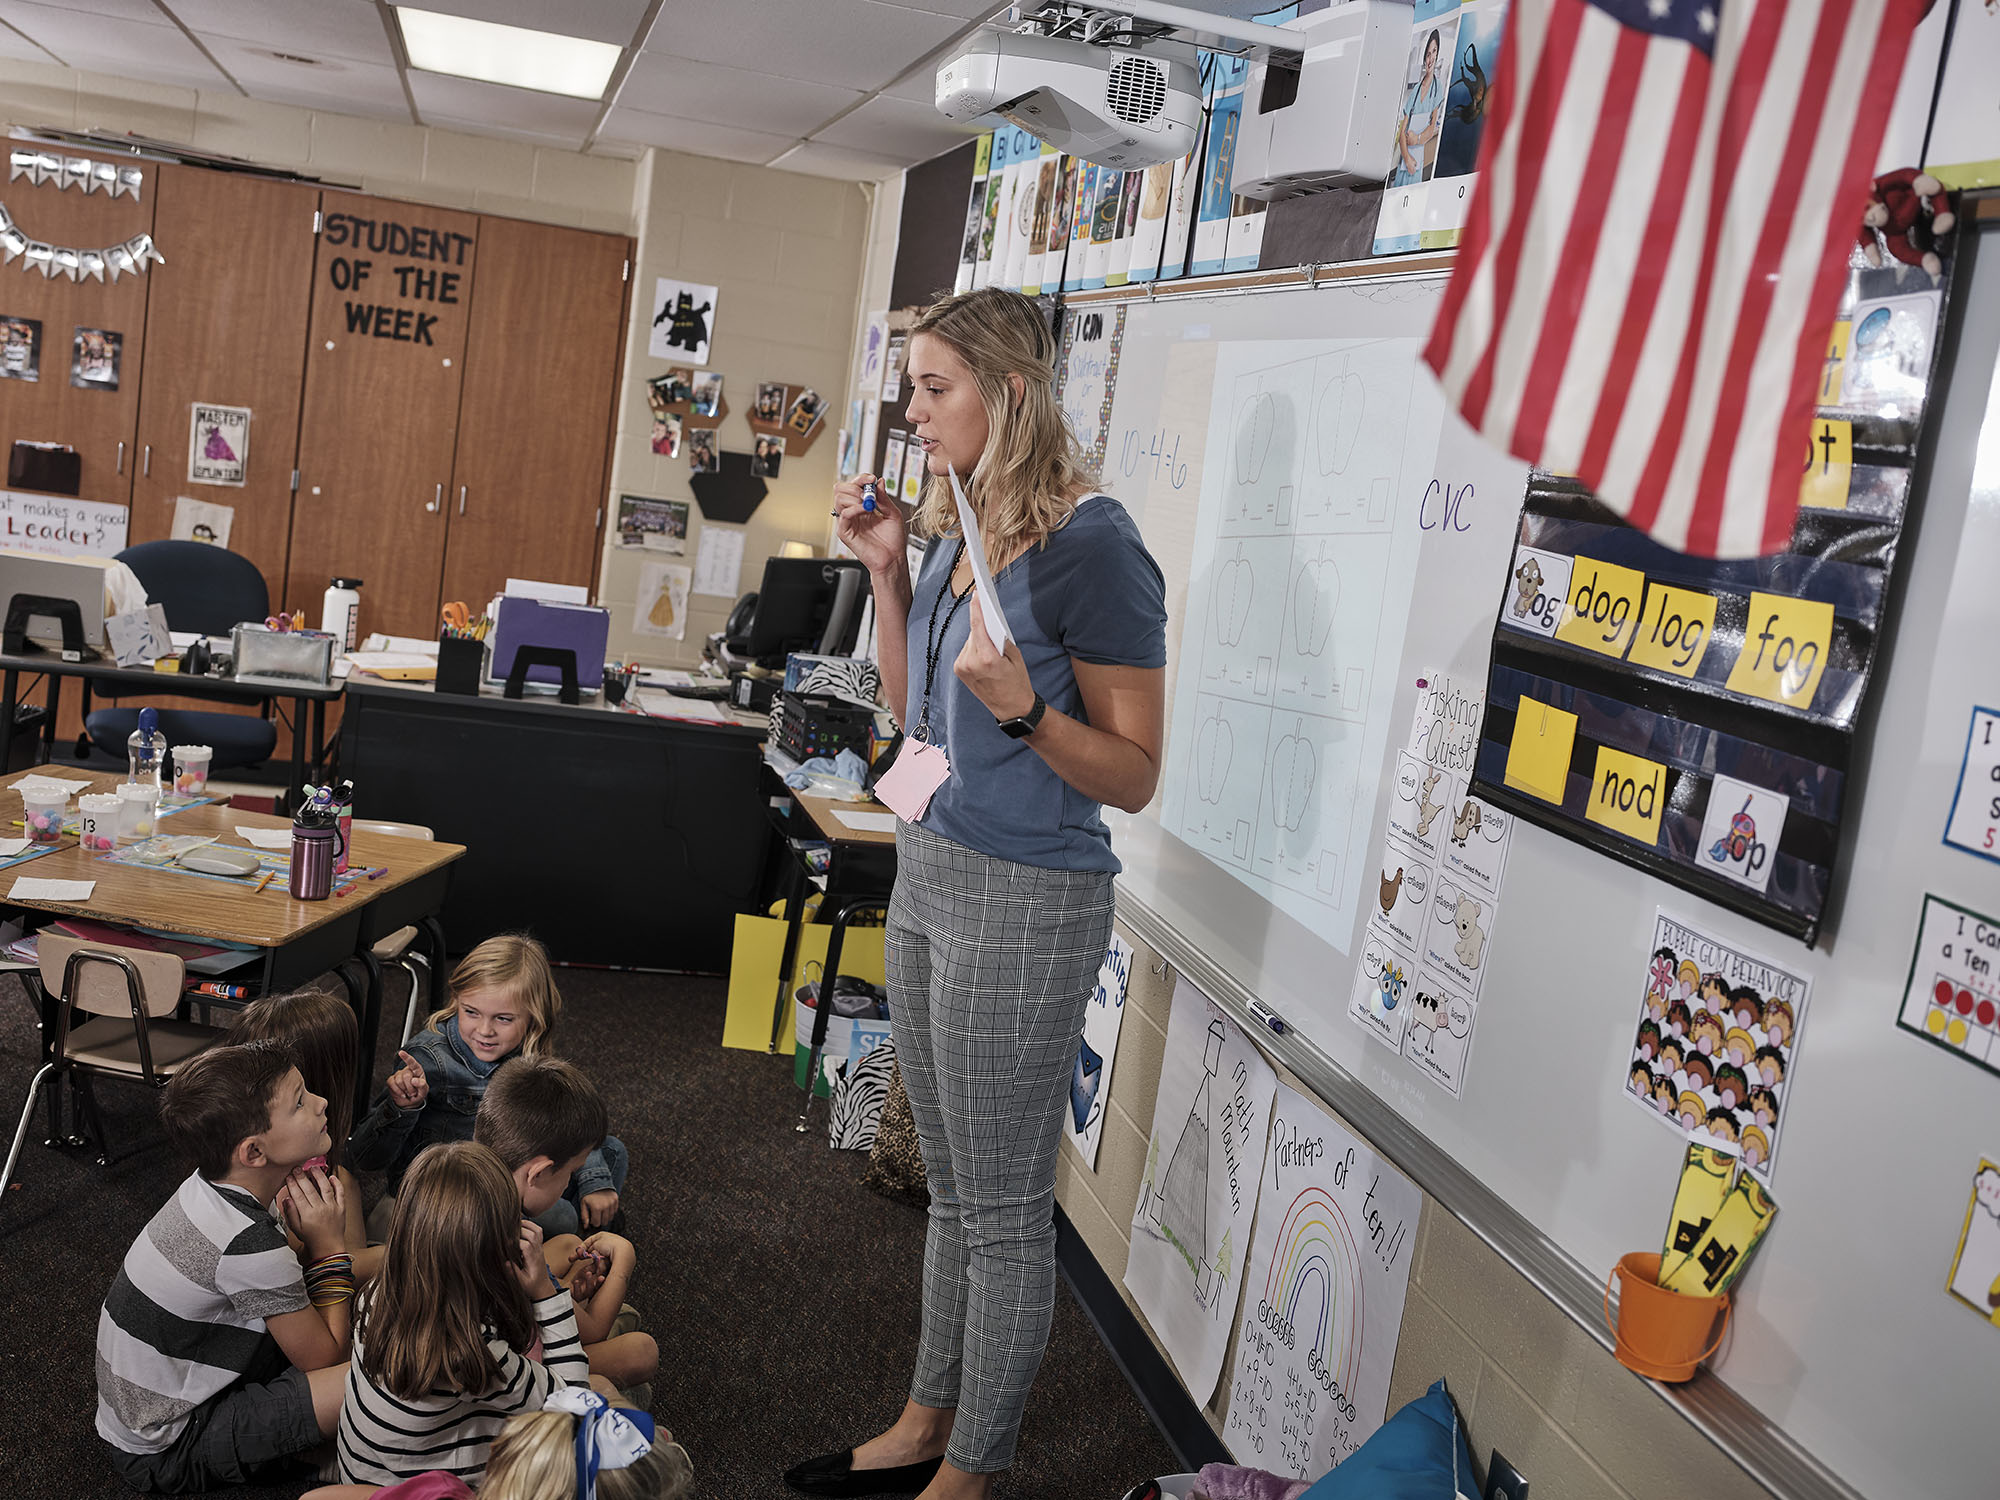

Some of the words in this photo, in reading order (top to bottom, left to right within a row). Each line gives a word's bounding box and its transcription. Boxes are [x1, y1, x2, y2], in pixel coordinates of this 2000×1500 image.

[978, 143, 989, 168] A
[1014, 129, 1023, 155] C
[1458, 185, 1465, 199] o
[325, 213, 473, 266] STUDENT
[330, 257, 372, 291] OF
[394, 266, 461, 304] THE
[345, 301, 438, 347] WEEK
[1082, 312, 1104, 343] CAN
[1081, 384, 1093, 398] or
[23, 500, 69, 520] makes
[76, 510, 86, 522] a
[94, 507, 127, 528] good
[1420, 479, 1474, 532] CVC
[8, 516, 105, 549] Leader?
[1531, 591, 1561, 629] og
[1574, 571, 1631, 643] dog
[1651, 592, 1704, 667] log
[1752, 614, 1818, 694] fog
[1425, 674, 1479, 753] Asking
[1983, 721, 1993, 745] I
[1601, 768, 1660, 820] nod
[83, 817, 96, 833] 13
[1983, 827, 1997, 849] 5
[1957, 915, 1965, 936] I
[1662, 923, 1699, 958] BUBBLE
[1700, 942, 1729, 973] GUM
[1731, 955, 1798, 1001] BEHAVIOR
[1942, 943, 1952, 959] a
[1965, 948, 1990, 977] Ten
[1273, 1118, 1324, 1191] Partners
[1334, 1147, 1355, 1190] of
[1362, 1175, 1407, 1272] ten!!
